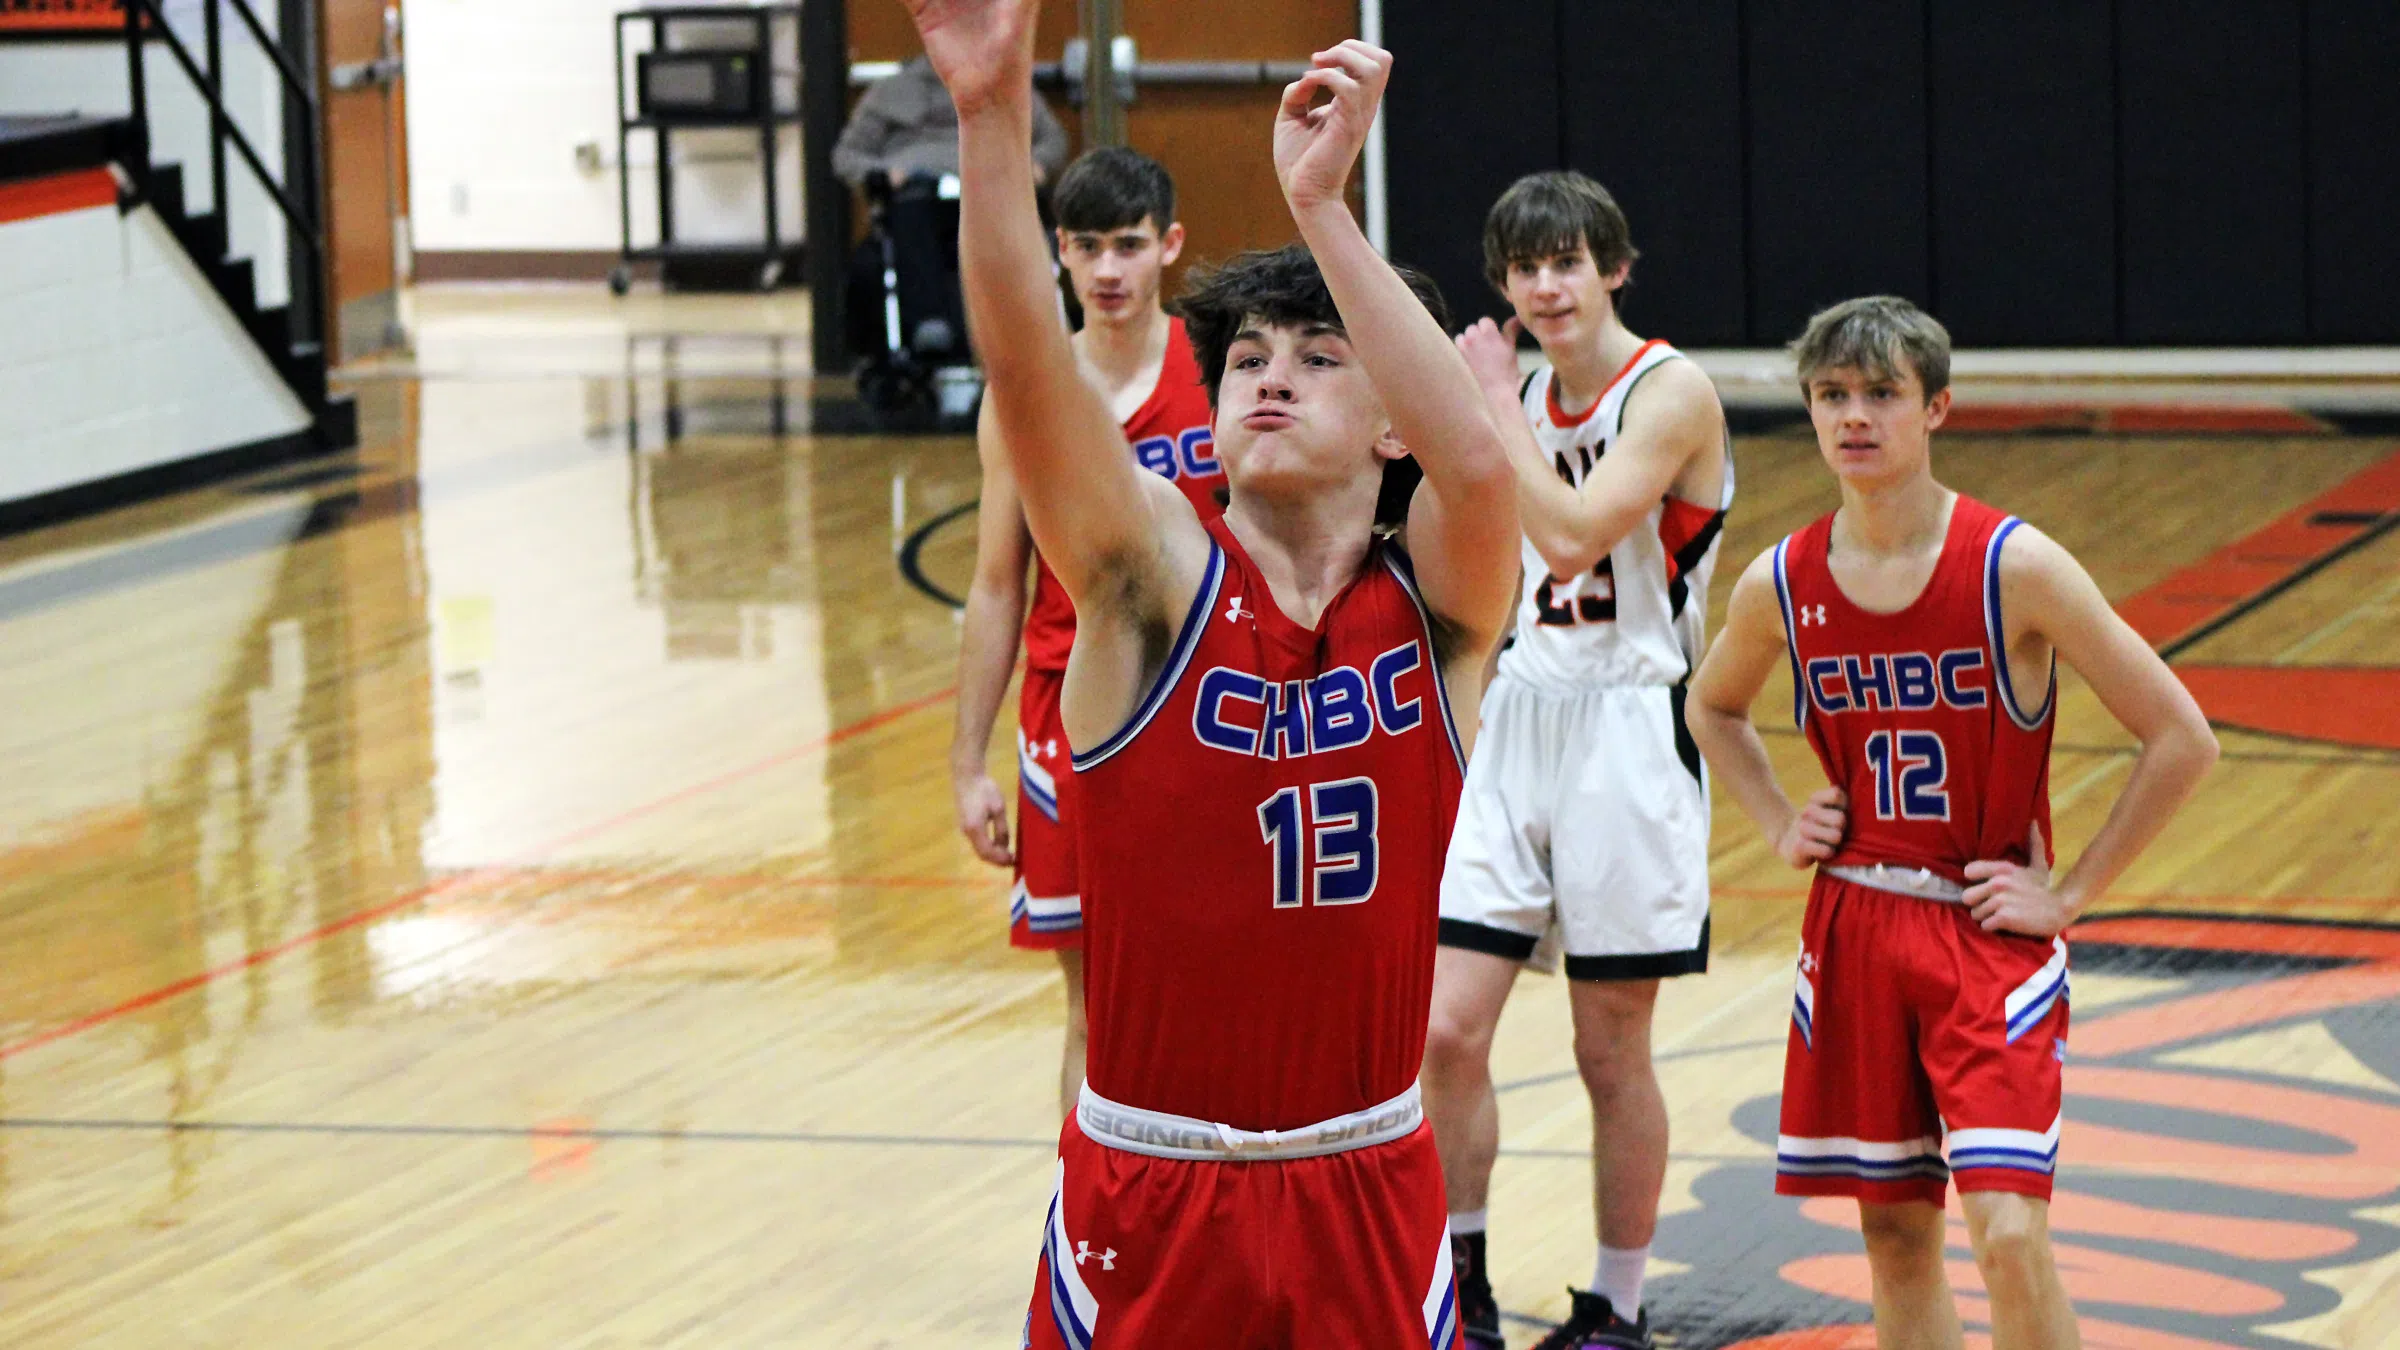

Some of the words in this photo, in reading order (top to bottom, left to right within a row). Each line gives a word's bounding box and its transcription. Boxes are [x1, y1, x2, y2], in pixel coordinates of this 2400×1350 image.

[1132, 424, 1222, 483] BC
[1192, 638, 1423, 761] CHBC
[1806, 647, 1987, 715] CHBC
[1865, 729, 1951, 822] 12
[1256, 776, 1380, 909] 13
